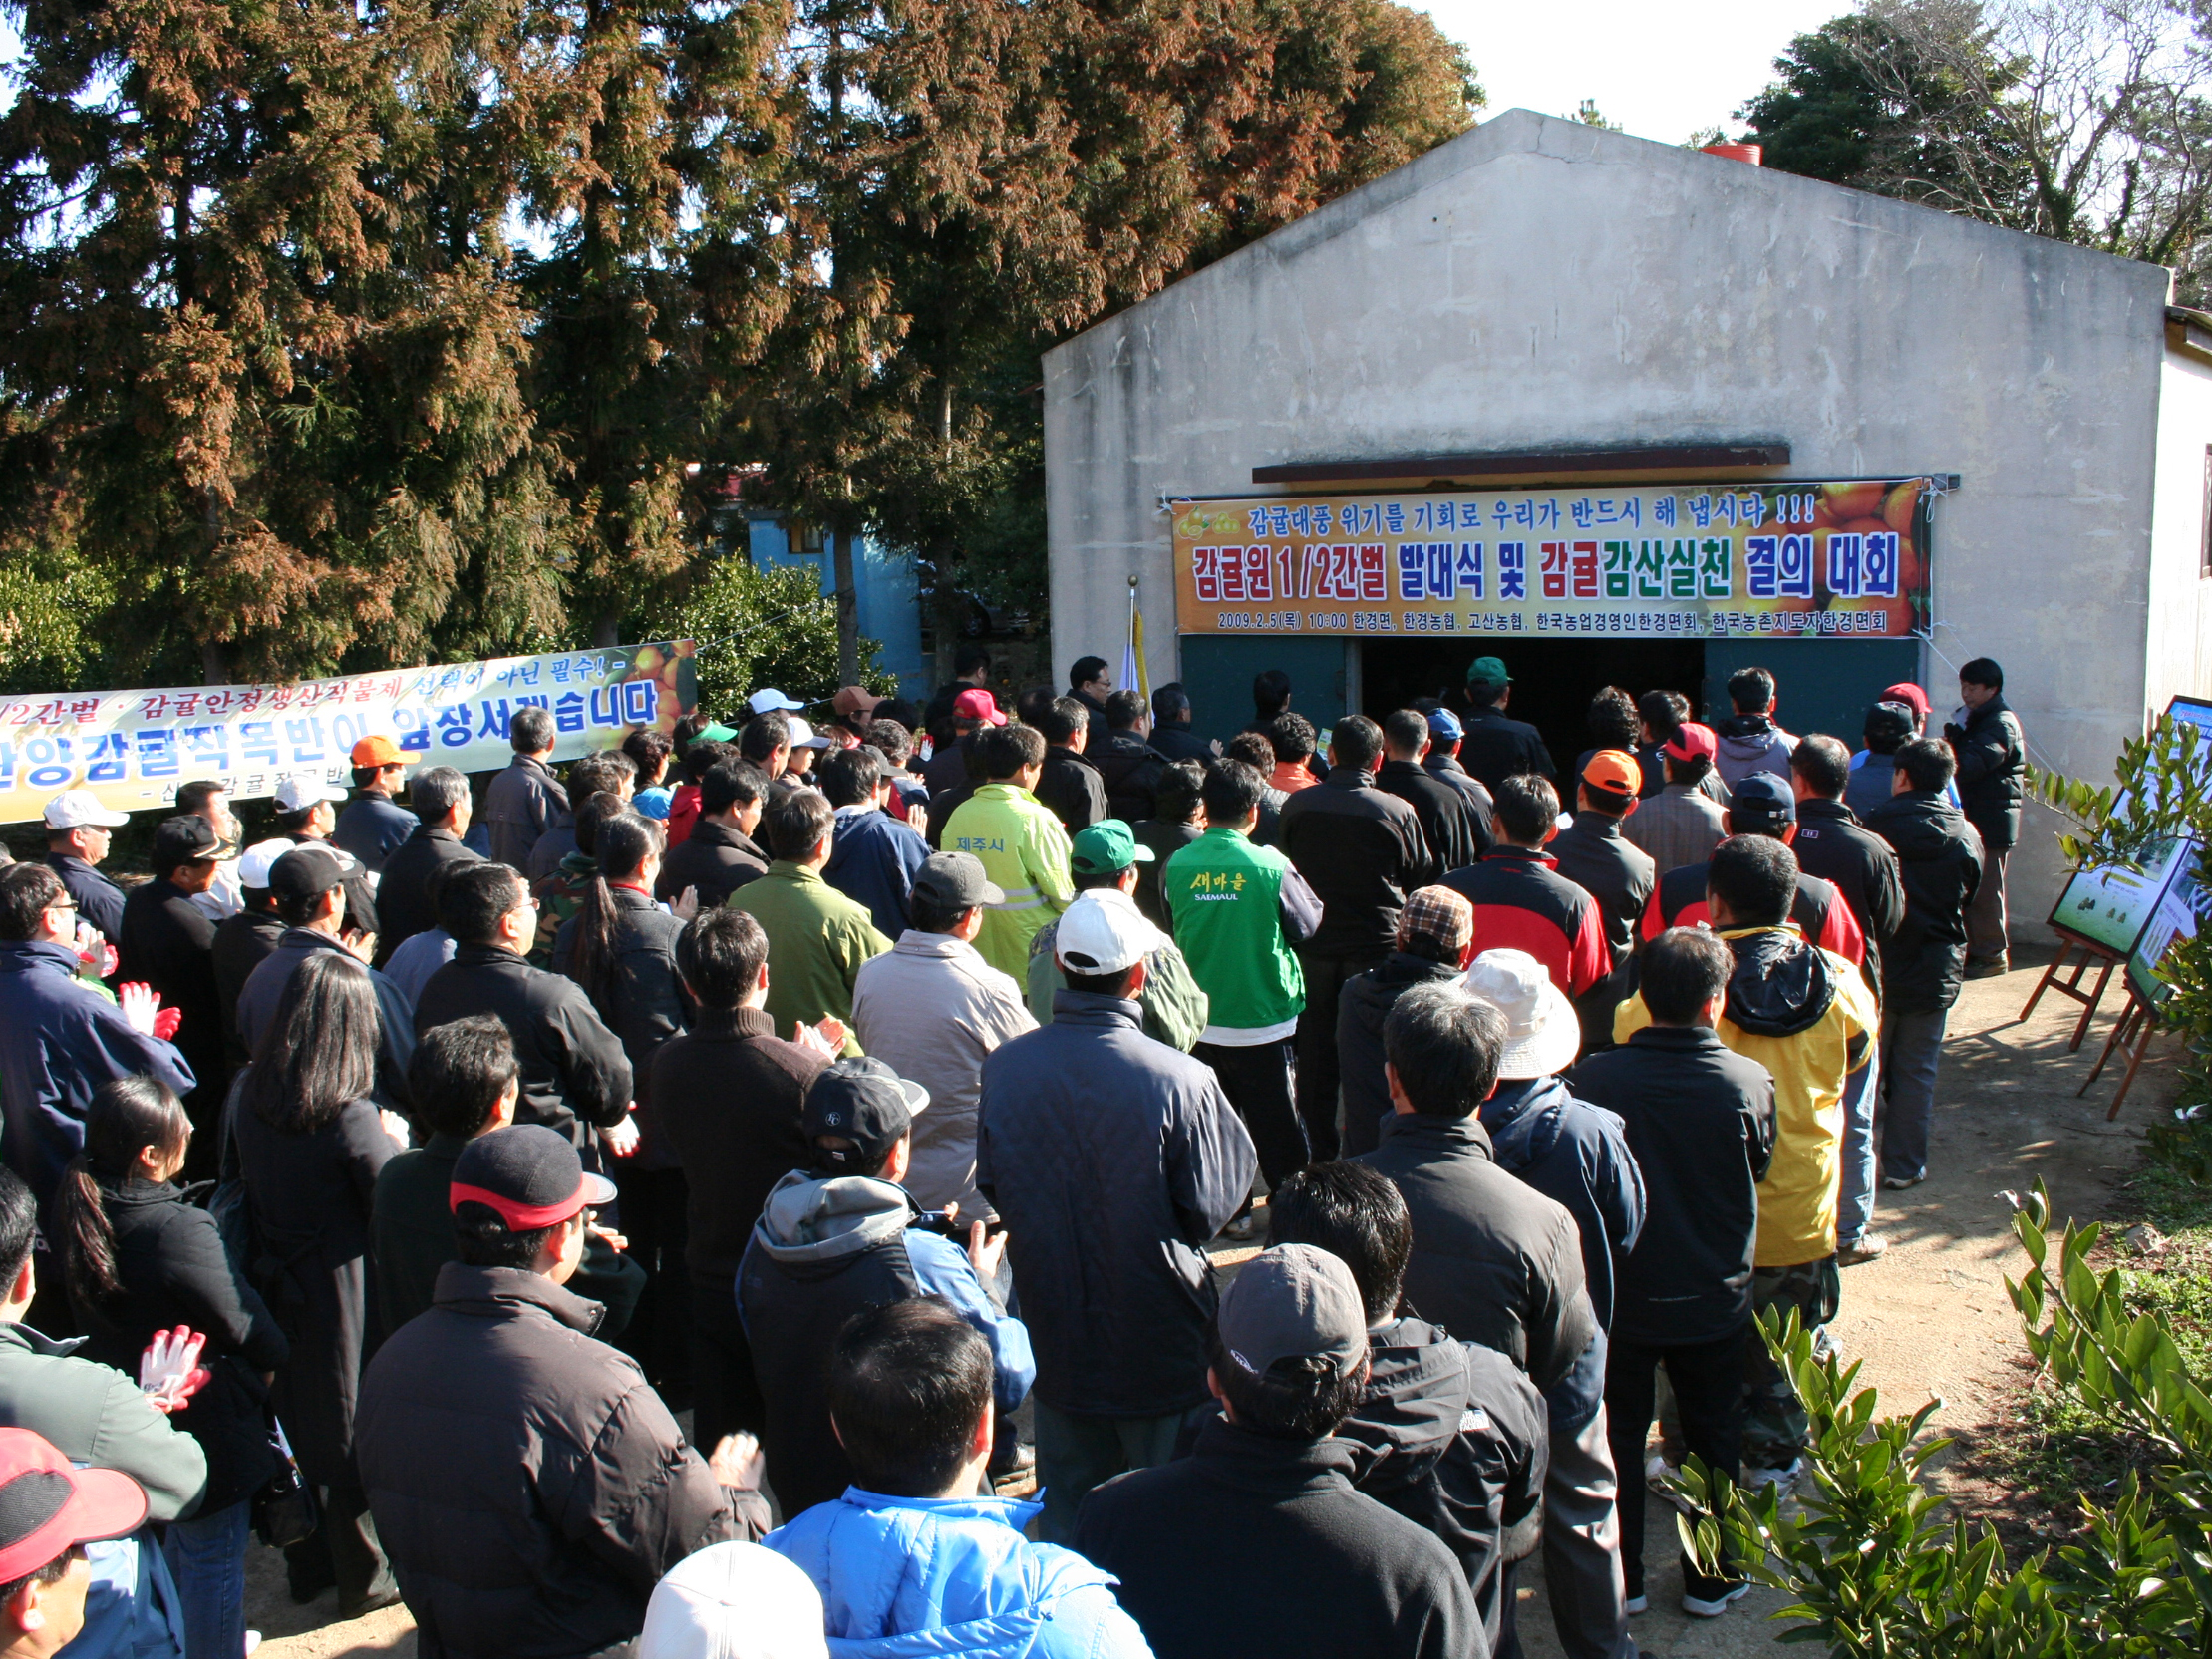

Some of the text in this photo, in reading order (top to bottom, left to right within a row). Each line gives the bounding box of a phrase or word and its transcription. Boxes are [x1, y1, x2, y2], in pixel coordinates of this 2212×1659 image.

[1249, 504, 1332, 537] 감귤대풍
[1341, 503, 1405, 535] 위기를
[1414, 501, 1481, 533] 기회로
[1491, 498, 1560, 531] 우리가
[1570, 497, 1641, 529] 반드시
[1654, 496, 1676, 528] 해
[1688, 493, 1765, 528] 냅시다
[1399, 543, 1483, 598] 발대식
[1497, 541, 1526, 599] 및
[1747, 535, 1811, 597] 결의
[1828, 534, 1898, 596] 대회
[1218, 611, 1302, 630] 2009.2.5(목)
[1308, 612, 1347, 629] 10:00
[496, 661, 540, 689] 아닌
[393, 680, 657, 750] 앞장서습니다
[956, 837, 1004, 852] 제주시
[1189, 871, 1247, 893] 새마을
